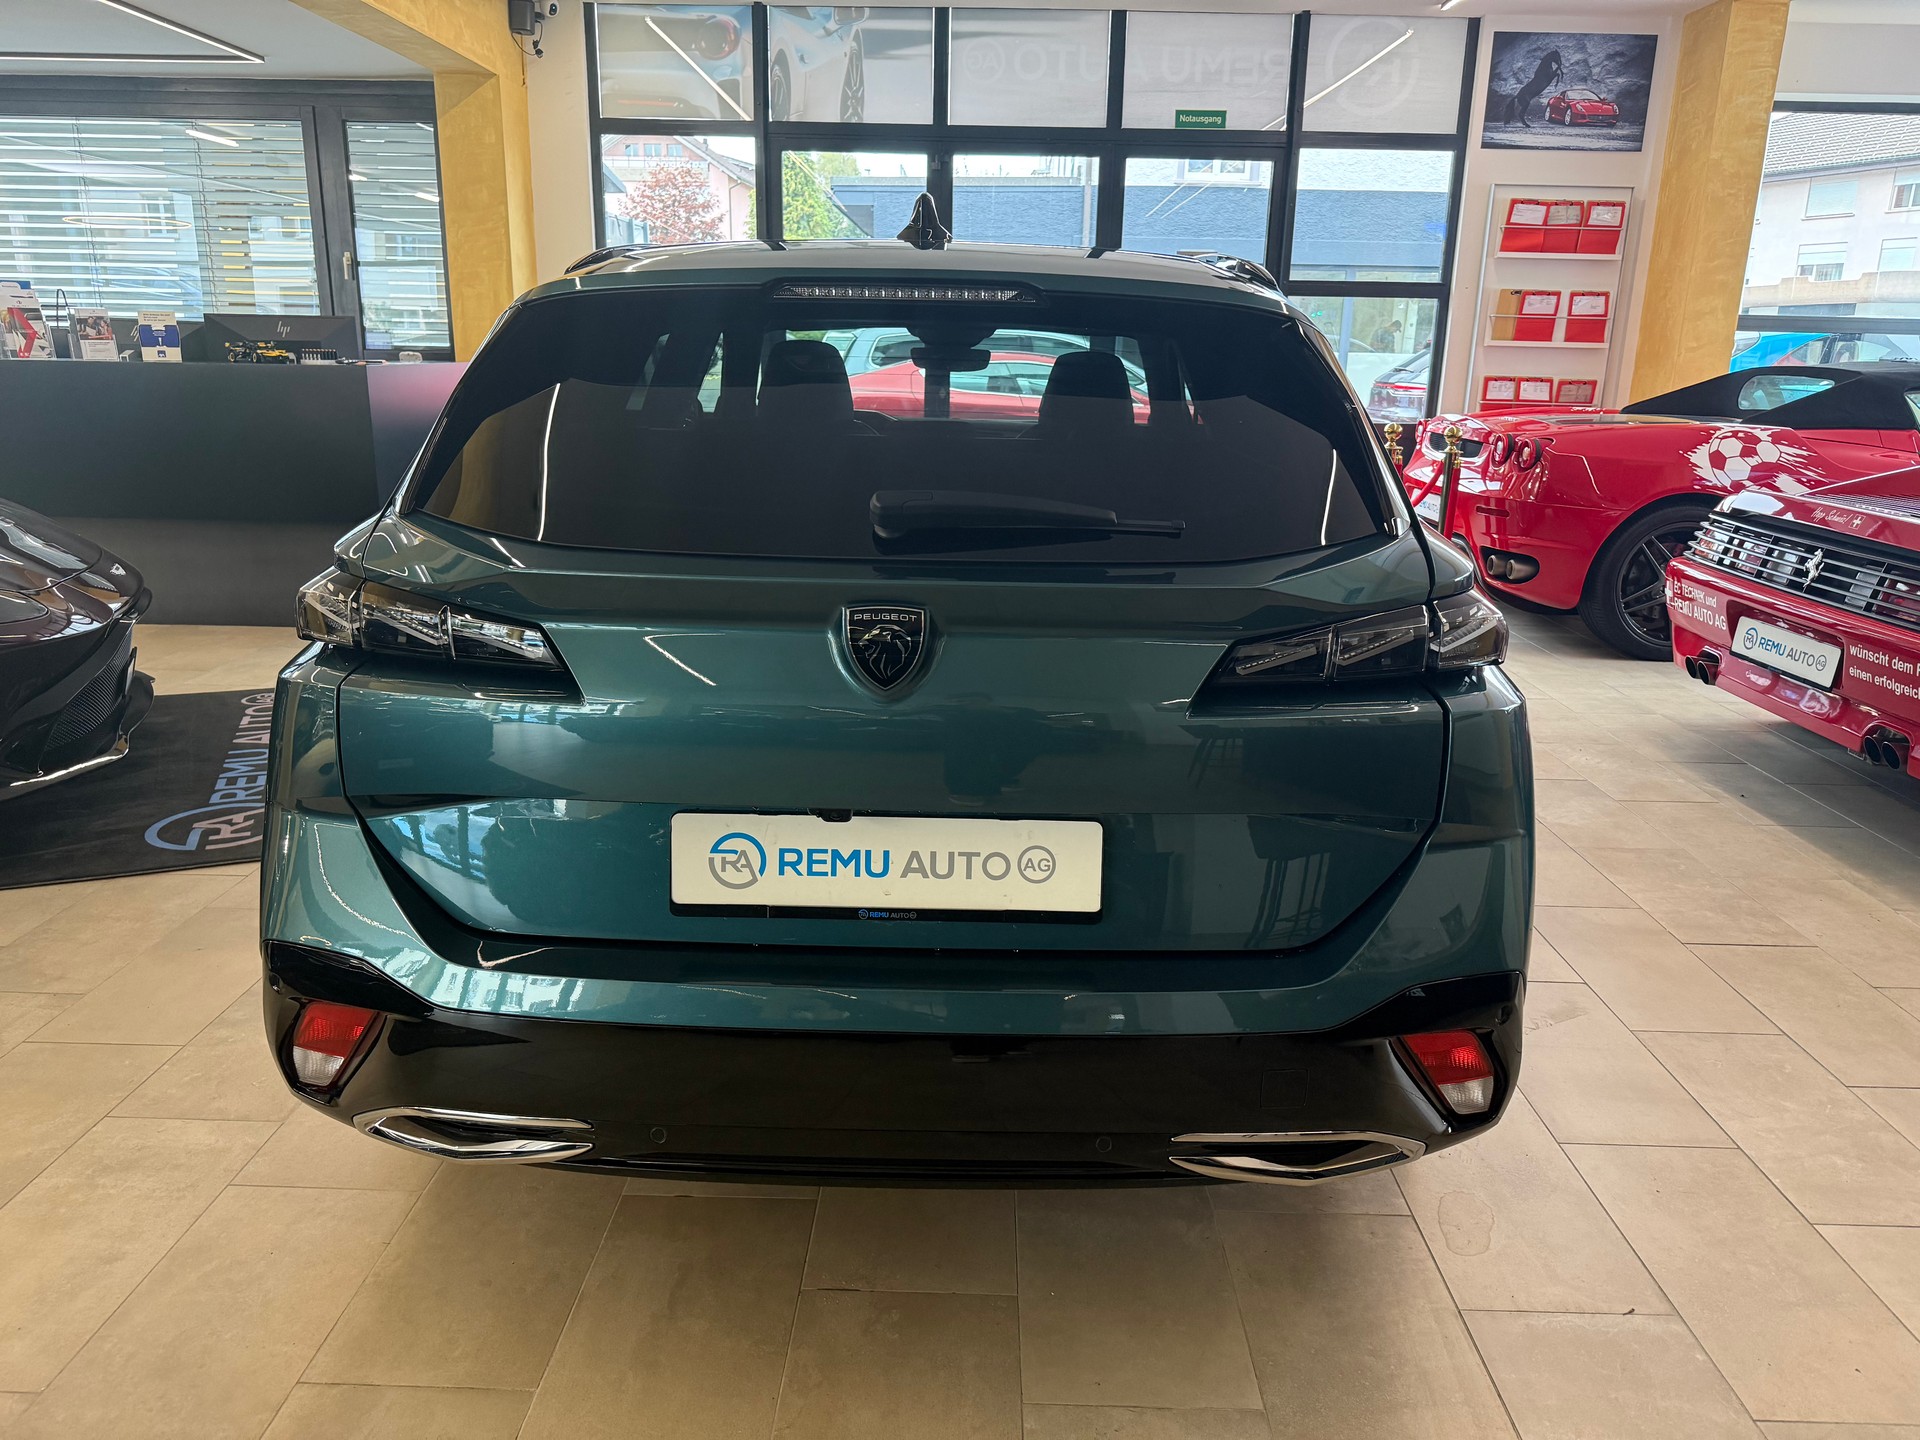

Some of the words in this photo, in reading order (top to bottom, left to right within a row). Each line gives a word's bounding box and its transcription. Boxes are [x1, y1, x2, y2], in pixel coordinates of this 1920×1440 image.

[1179, 113, 1222, 126] Notausgang
[277, 320, 291, 338] hp
[1682, 584, 1705, 604] TECHNIK
[1705, 595, 1717, 608] und
[854, 613, 918, 623] PEUGEOT
[1674, 597, 1692, 617] REMU
[1693, 605, 1713, 625] AUTO
[1714, 613, 1727, 631] AG
[1758, 636, 1787, 657] REMU
[1786, 649, 1816, 667] AUTO
[1849, 644, 1889, 667] wünscht
[1891, 656, 1914, 675] dem
[1849, 665, 1873, 683] einen
[209, 748, 269, 804] REMU
[778, 847, 891, 878] REMU
[900, 850, 1012, 881] AUTO
